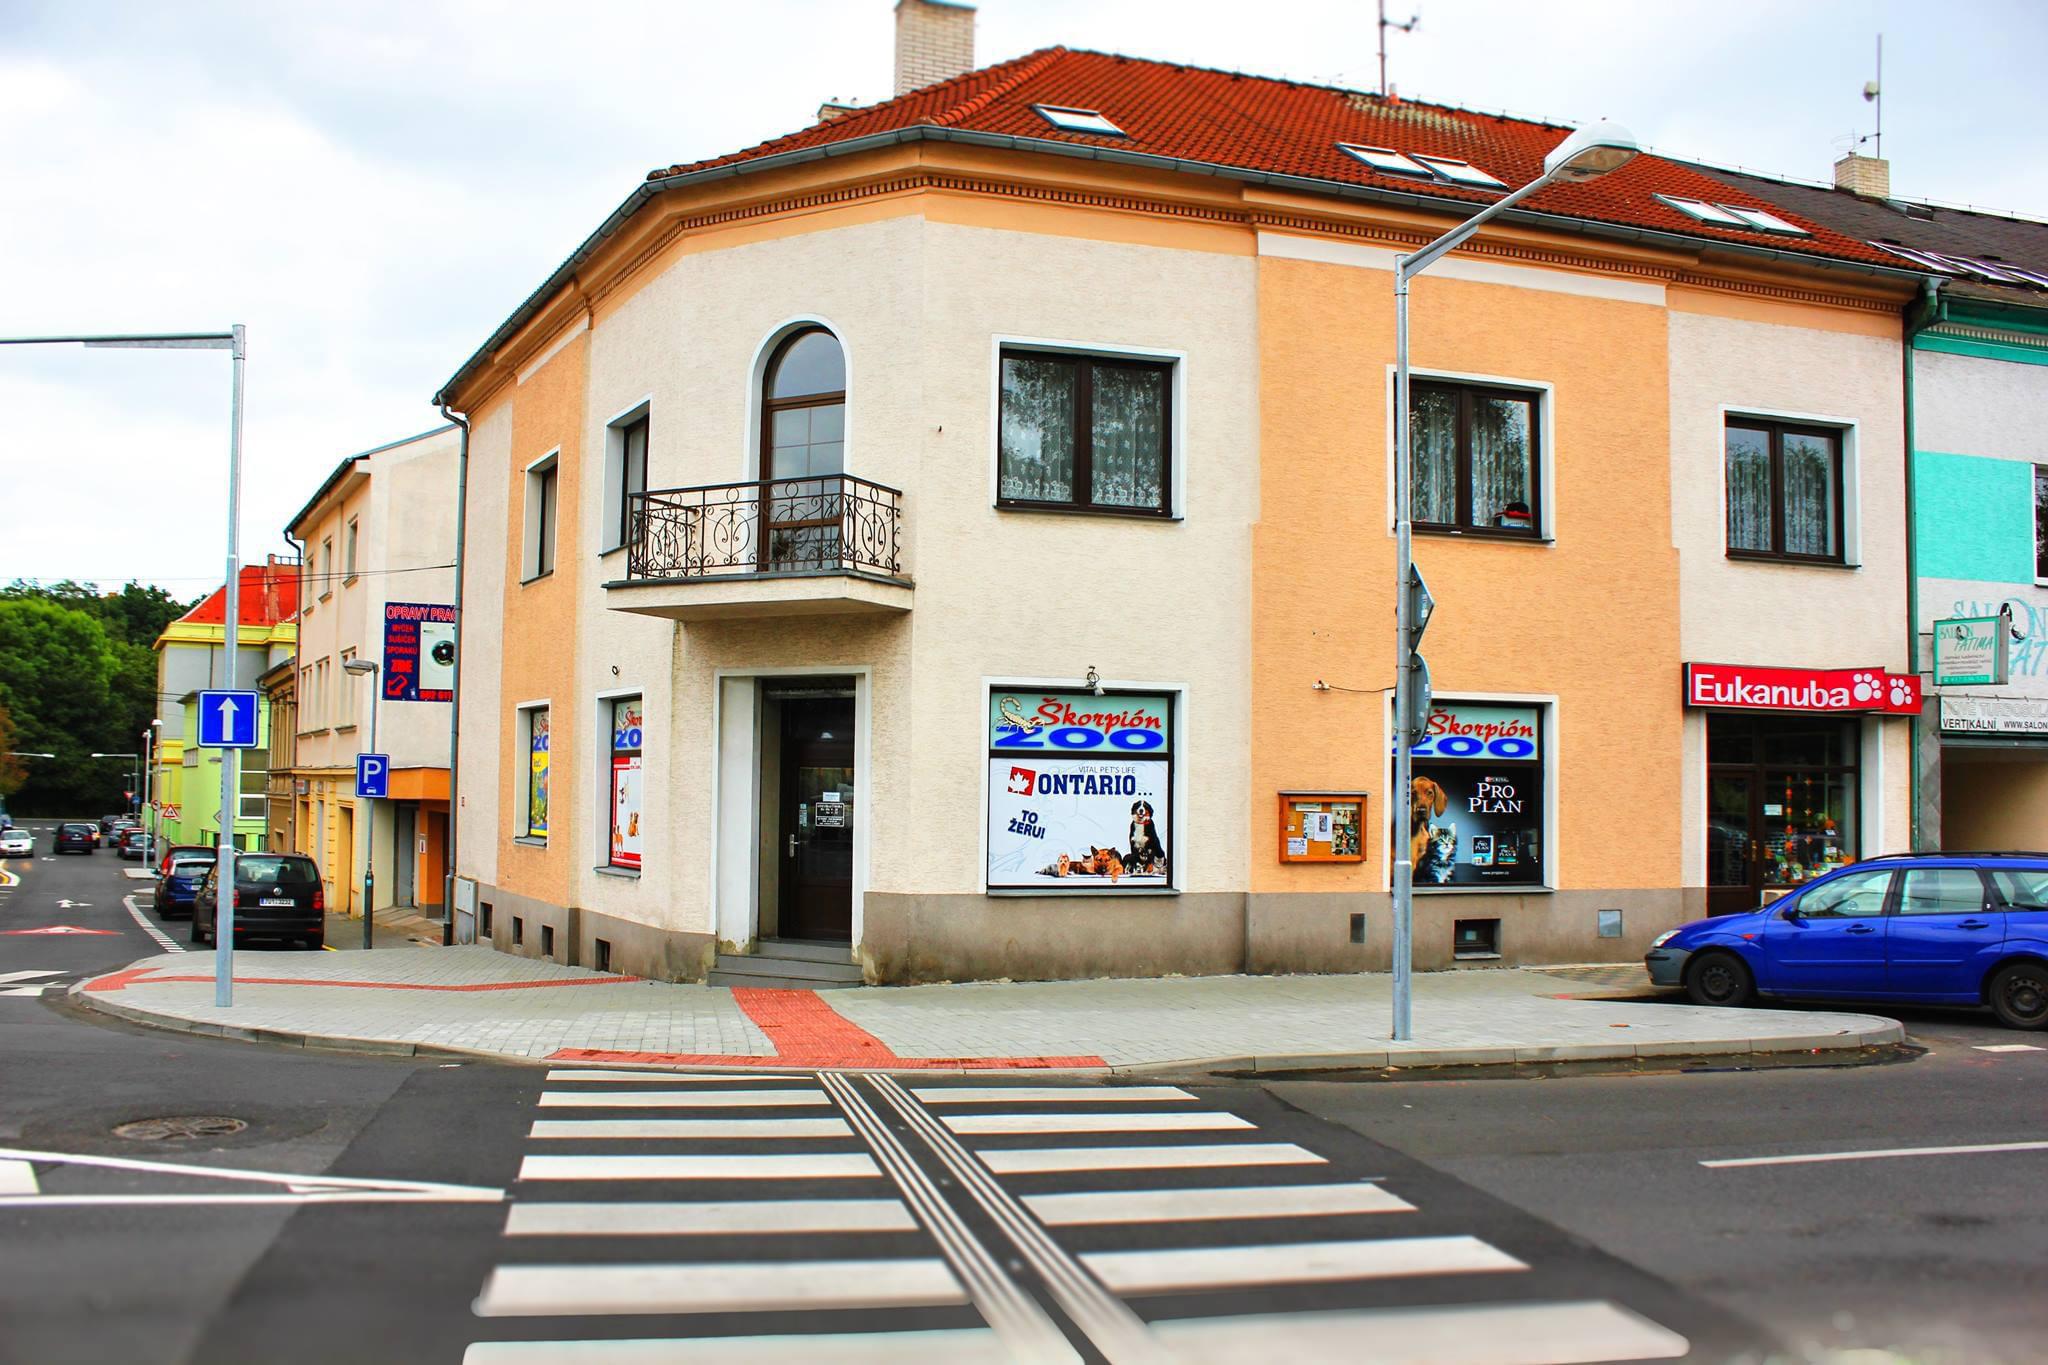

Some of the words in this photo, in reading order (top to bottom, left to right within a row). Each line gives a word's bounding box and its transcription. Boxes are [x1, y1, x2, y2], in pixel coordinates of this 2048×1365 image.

[386, 605, 429, 620] OPRAVY
[1954, 635, 1993, 651] FATIMA
[1694, 673, 1850, 708] Eukanuba
[1031, 697, 1162, 734] Škorpión
[1426, 708, 1534, 743] Škorpión
[995, 725, 1164, 751] ZOO
[363, 759, 382, 784] P
[1078, 766, 1099, 774] VITAL
[1100, 766, 1120, 774] PET'S
[1476, 782, 1516, 799] PRO
[1468, 797, 1524, 814] PLAN
[1021, 809, 1039, 825] TO
[1007, 817, 1046, 840] ŽERU!
